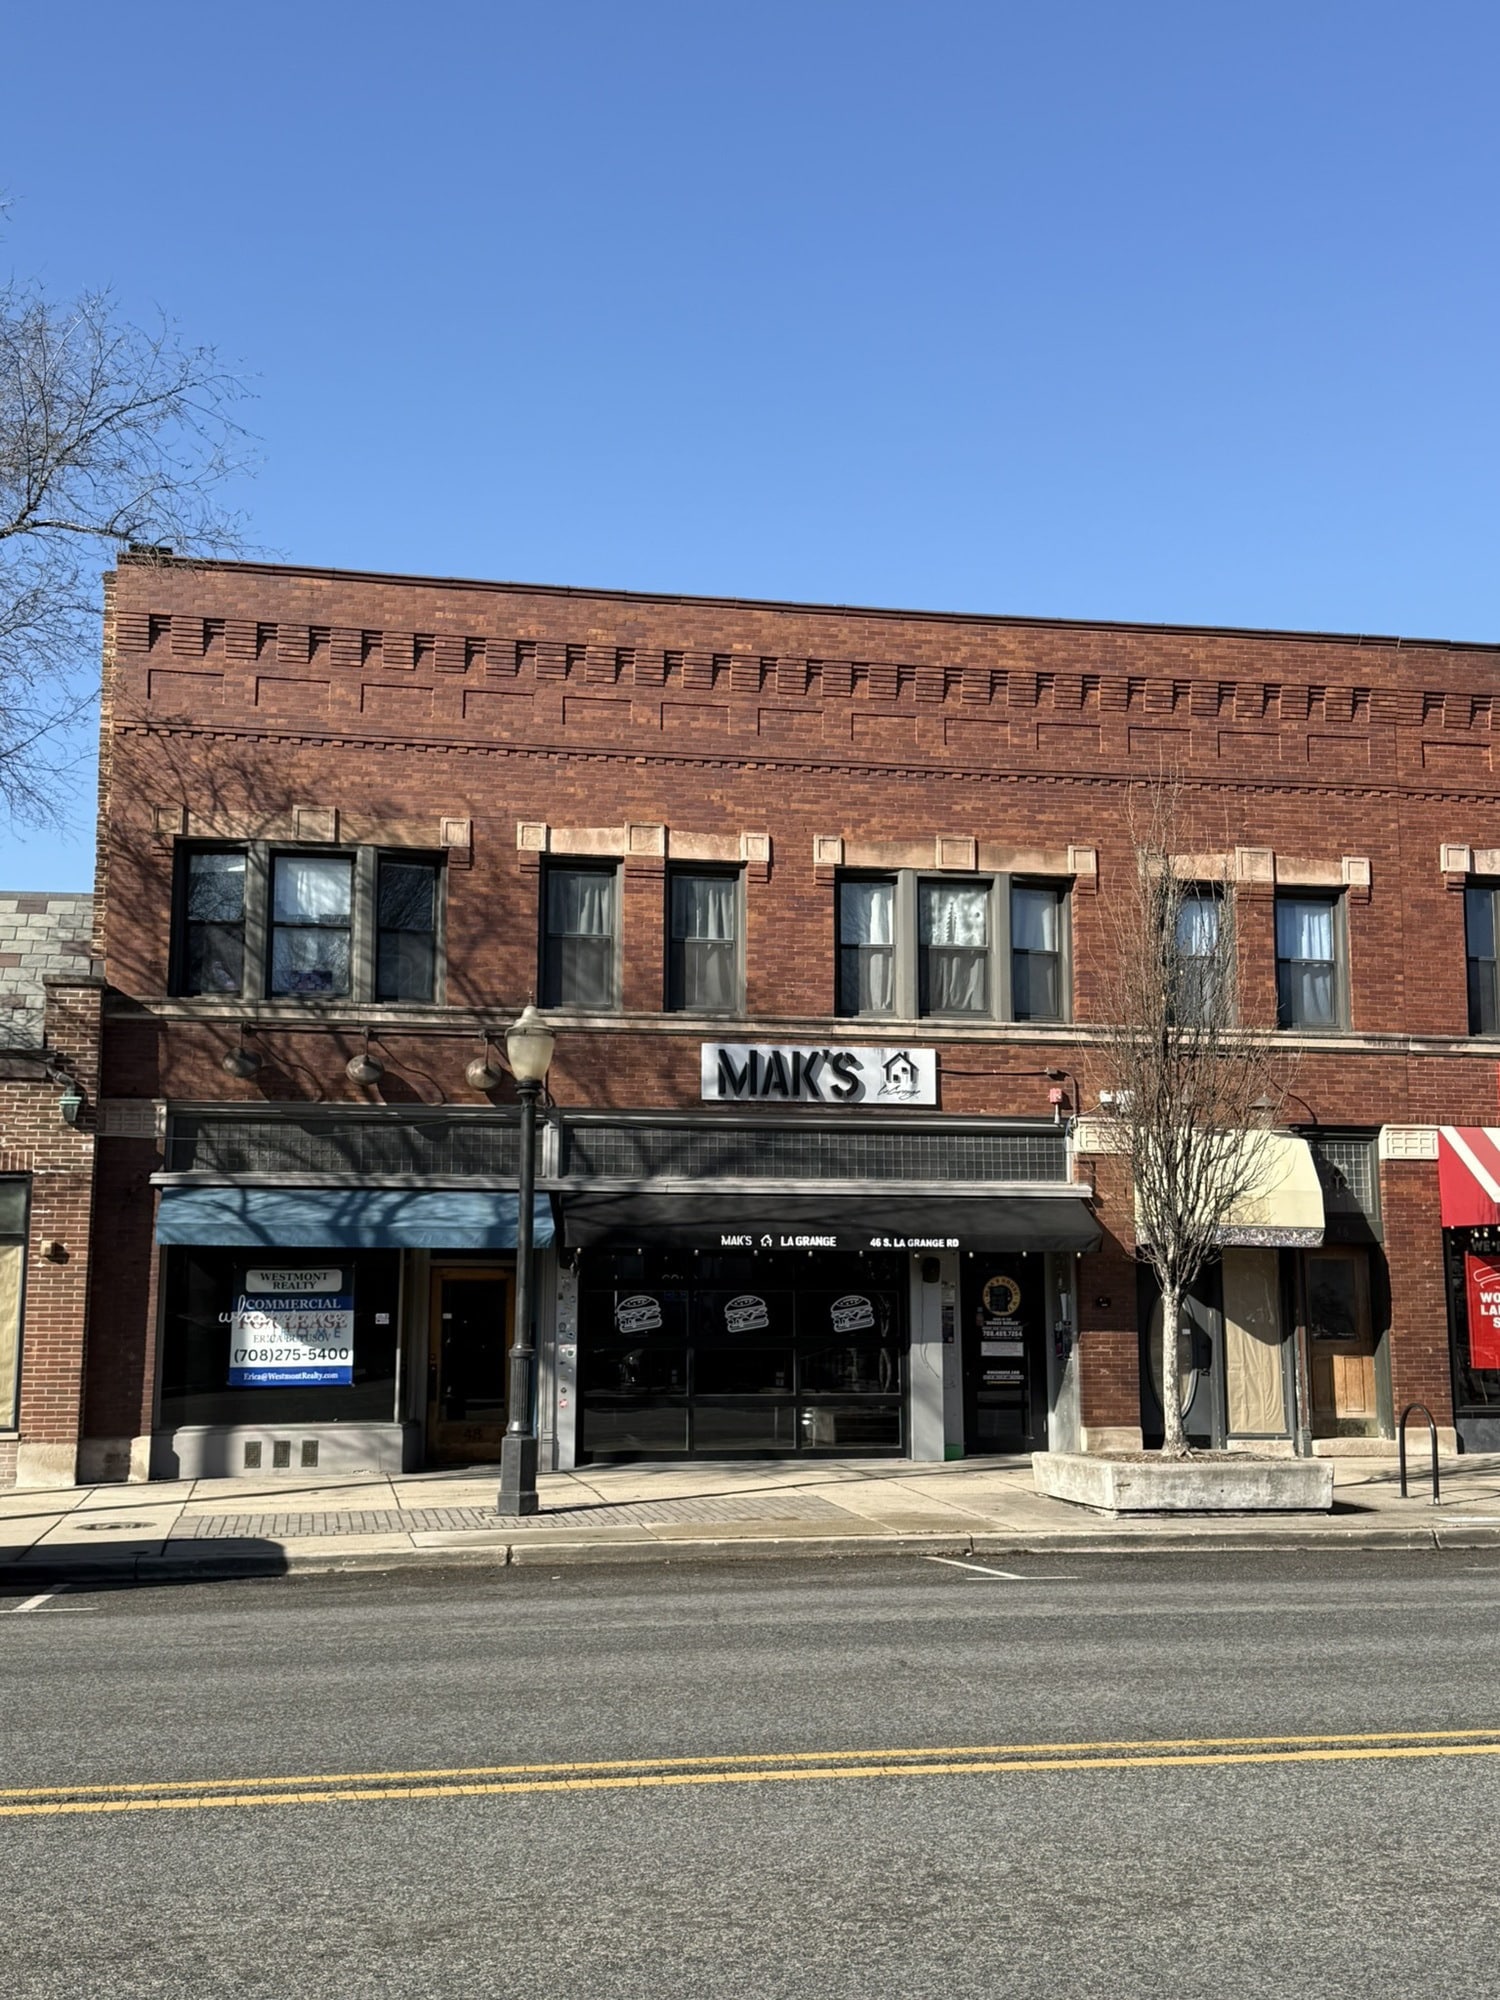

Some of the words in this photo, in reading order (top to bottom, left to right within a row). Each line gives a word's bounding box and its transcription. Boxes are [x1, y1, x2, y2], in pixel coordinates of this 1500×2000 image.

[717, 1049, 860, 1097] MAK'S
[721, 1235, 752, 1246] MAK'S
[780, 1236, 794, 1246] LA
[795, 1236, 837, 1247] GRANGE
[882, 1238, 892, 1247] S.
[893, 1238, 906, 1247] LA
[907, 1238, 945, 1247] GRANGE
[946, 1238, 959, 1247] RD
[260, 1272, 328, 1281] WESTMONT
[273, 1281, 317, 1290] REALTY
[245, 1299, 341, 1310] COMMERCIAL
[284, 1313, 348, 1329] LEASE
[234, 1347, 349, 1363] (708)275-5400
[243, 1371, 339, 1381] Erica@WestmontRealty.com
